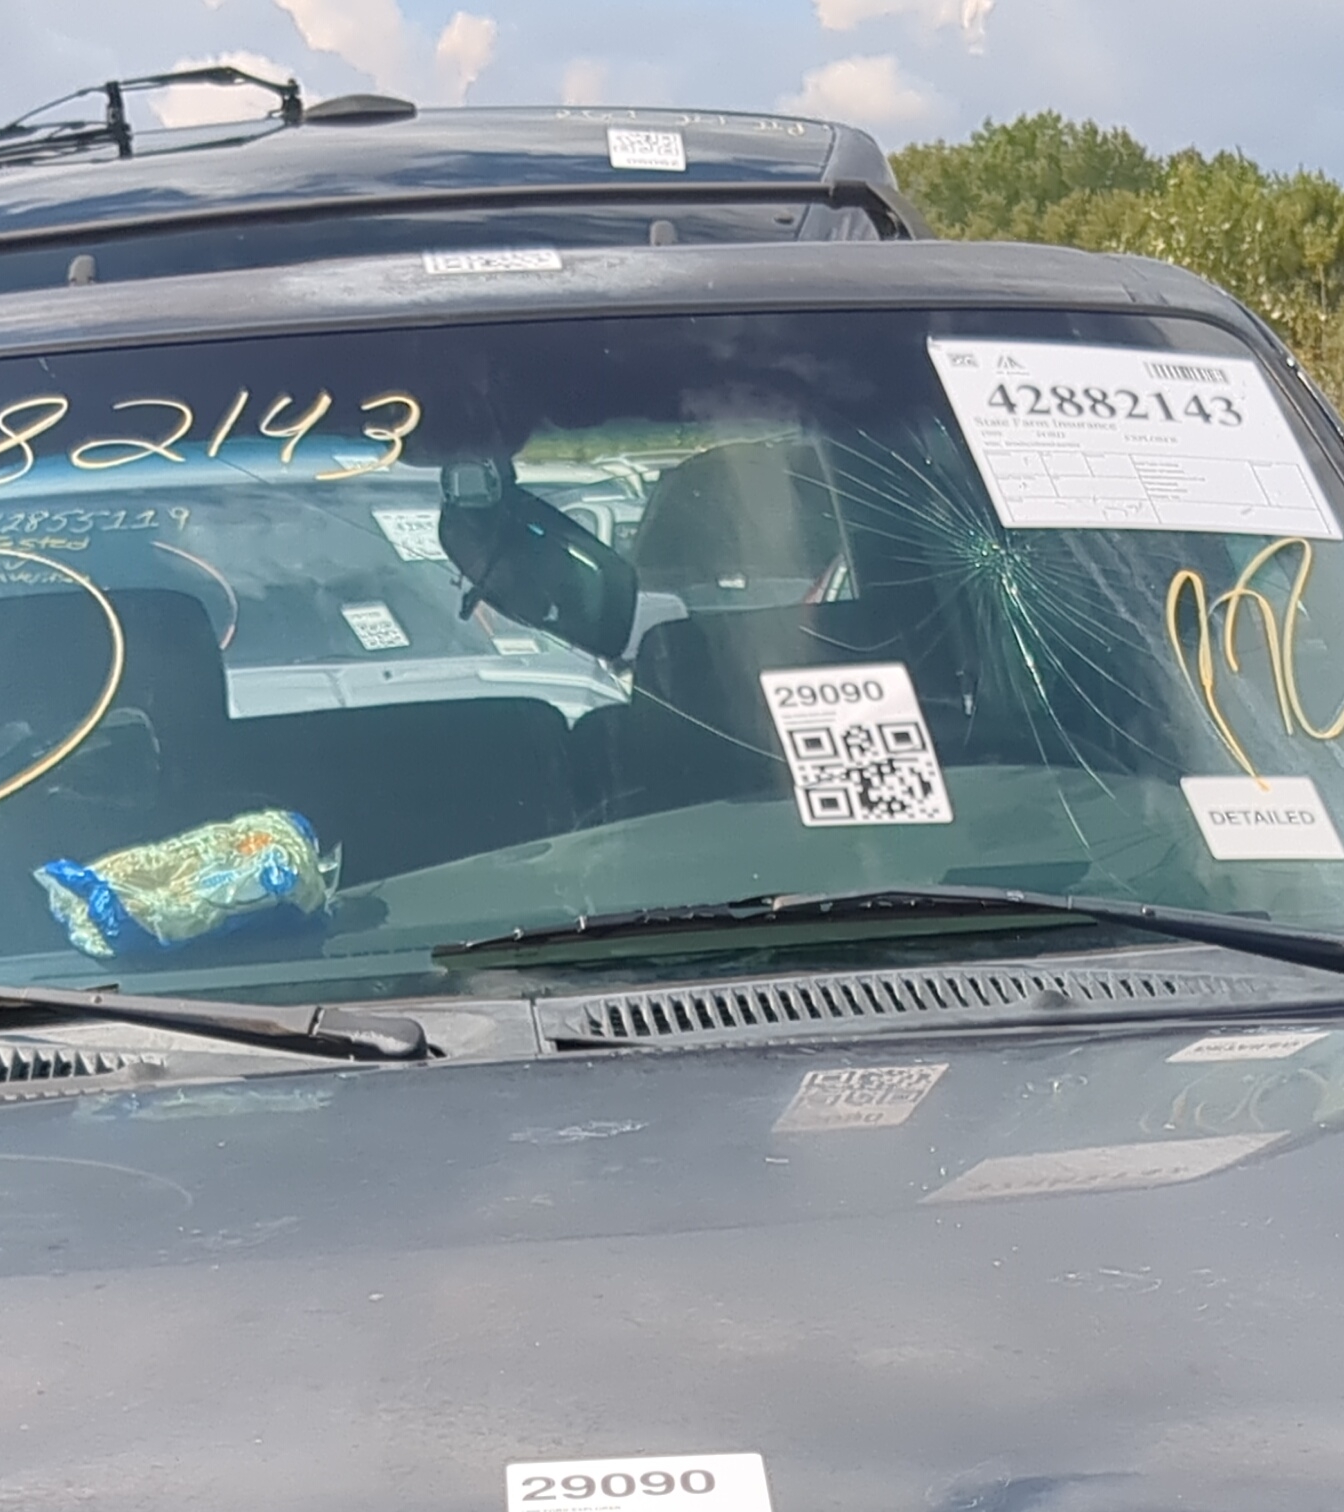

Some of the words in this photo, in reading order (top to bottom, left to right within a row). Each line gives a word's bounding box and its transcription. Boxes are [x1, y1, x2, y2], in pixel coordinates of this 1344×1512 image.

[986, 383, 1243, 427] 42882143
[1014, 417, 1049, 429] Farm
[1052, 418, 1118, 431] Insurance
[774, 680, 885, 708] 29090
[1209, 810, 1316, 826] DETAILED
[521, 1468, 716, 1502] 29090
